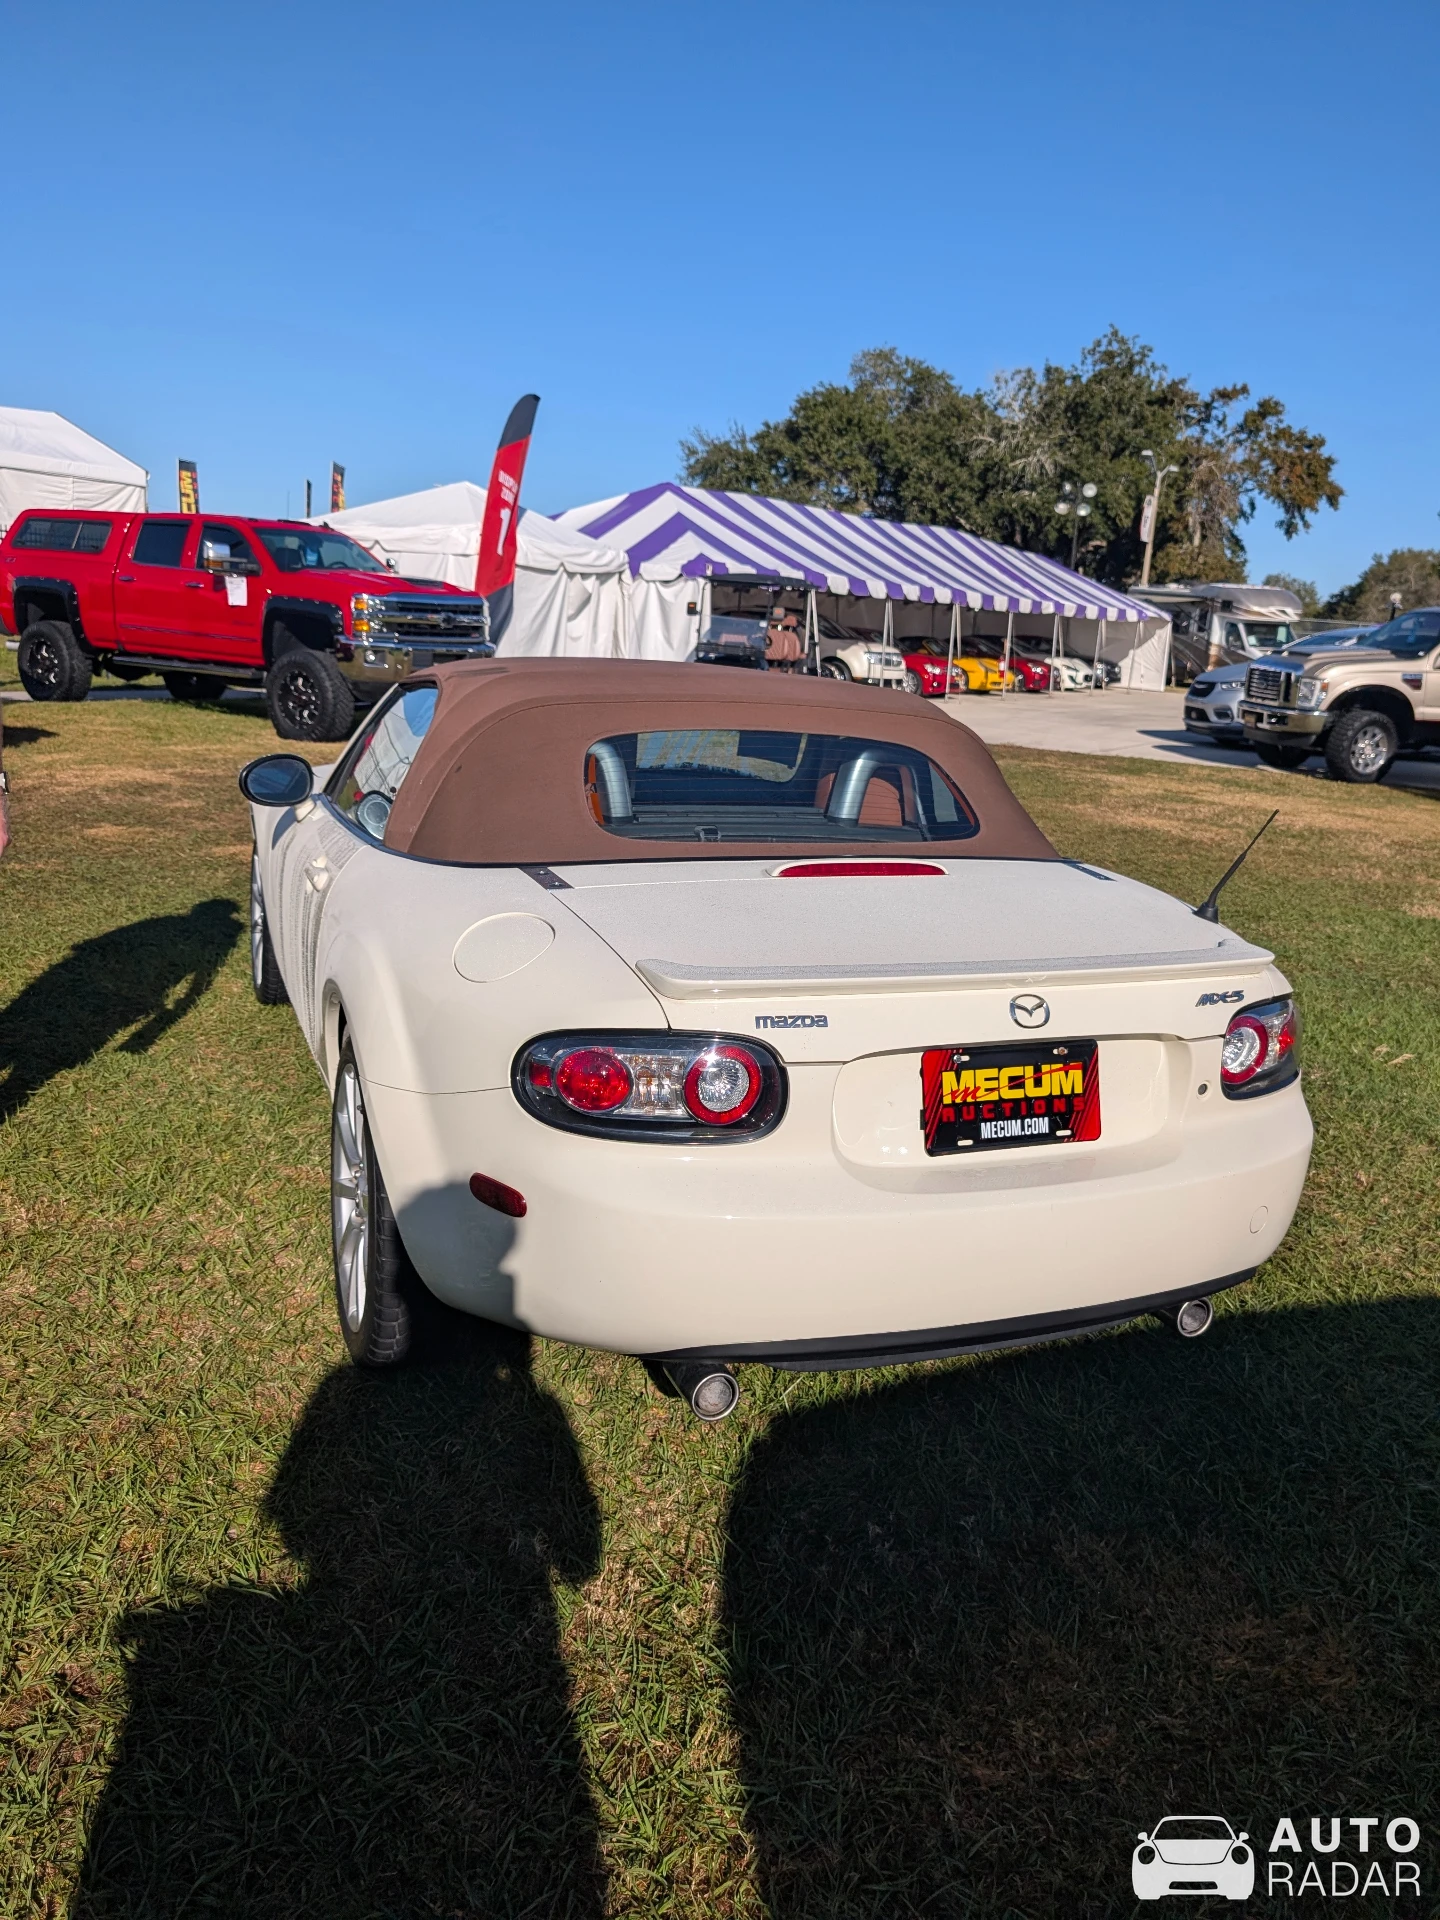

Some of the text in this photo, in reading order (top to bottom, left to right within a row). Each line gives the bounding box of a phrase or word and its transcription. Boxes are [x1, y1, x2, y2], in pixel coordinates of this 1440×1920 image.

[179, 469, 196, 514] CUM
[496, 506, 512, 557] 1
[754, 1015, 829, 1029] mazda
[941, 1061, 1084, 1105] MECUM
[942, 1096, 1086, 1123] AUCTIONS
[980, 1116, 1050, 1139] MECUM.COM
